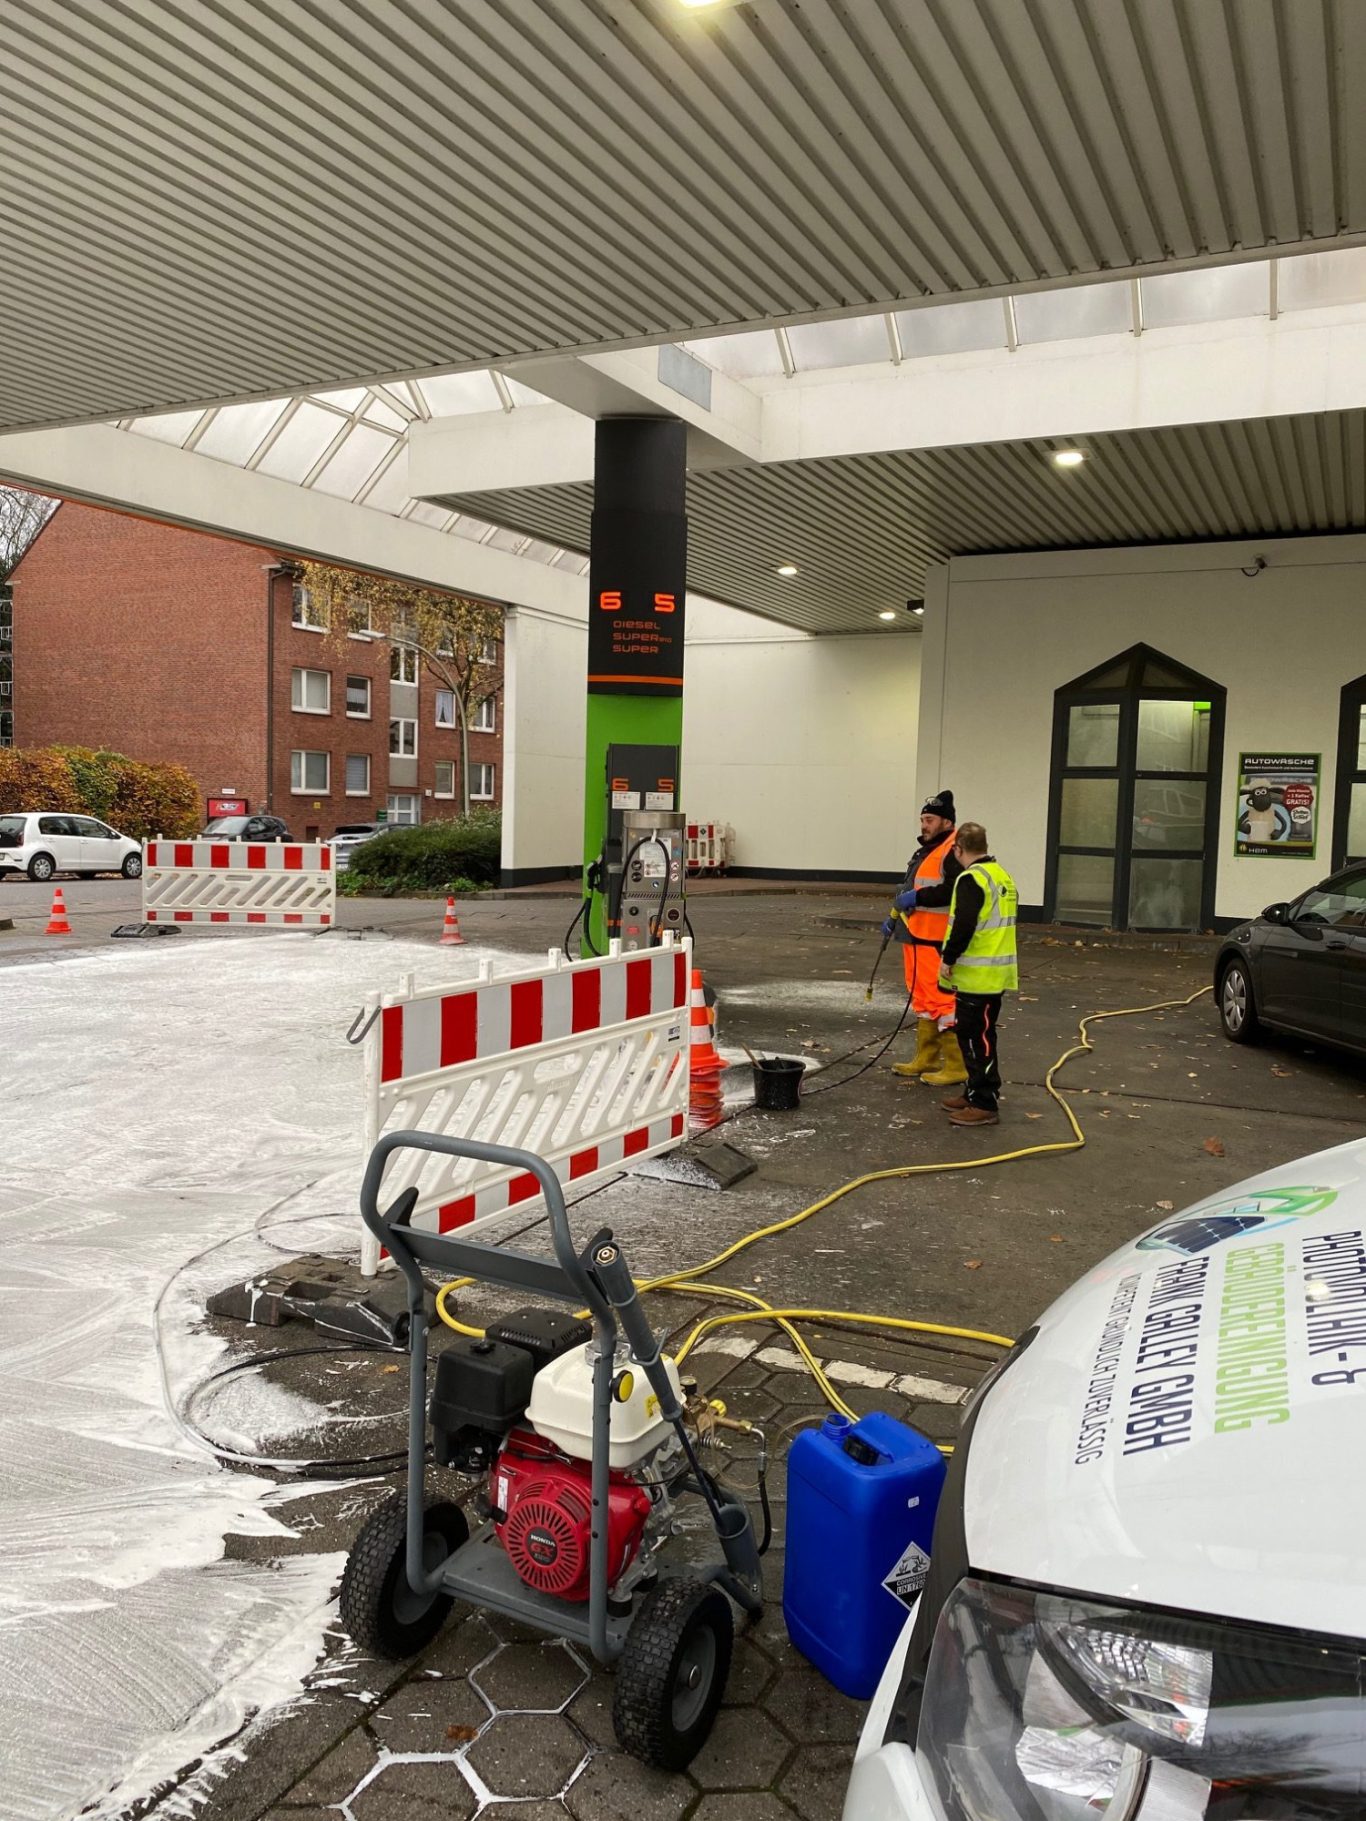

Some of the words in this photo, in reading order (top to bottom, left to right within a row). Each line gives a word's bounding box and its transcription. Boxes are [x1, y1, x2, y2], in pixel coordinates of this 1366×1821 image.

[600, 591, 621, 610] 6
[654, 593, 675, 613] 5
[613, 620, 661, 630] DIESEL
[612, 632, 659, 641] SUPER
[612, 644, 659, 653] SUPER
[612, 778, 629, 791] 6
[658, 779, 674, 792] 5
[1148, 1256, 1210, 1310] FRANK
[1135, 1303, 1202, 1374] GALLEY
[1215, 1242, 1296, 1433] GEBÄUDEREINIGUNG
[1075, 1374, 1117, 1464] ZUVERLÄSSIG
[1123, 1374, 1195, 1456] GMBH
[530, 1534, 556, 1547] HONDA
